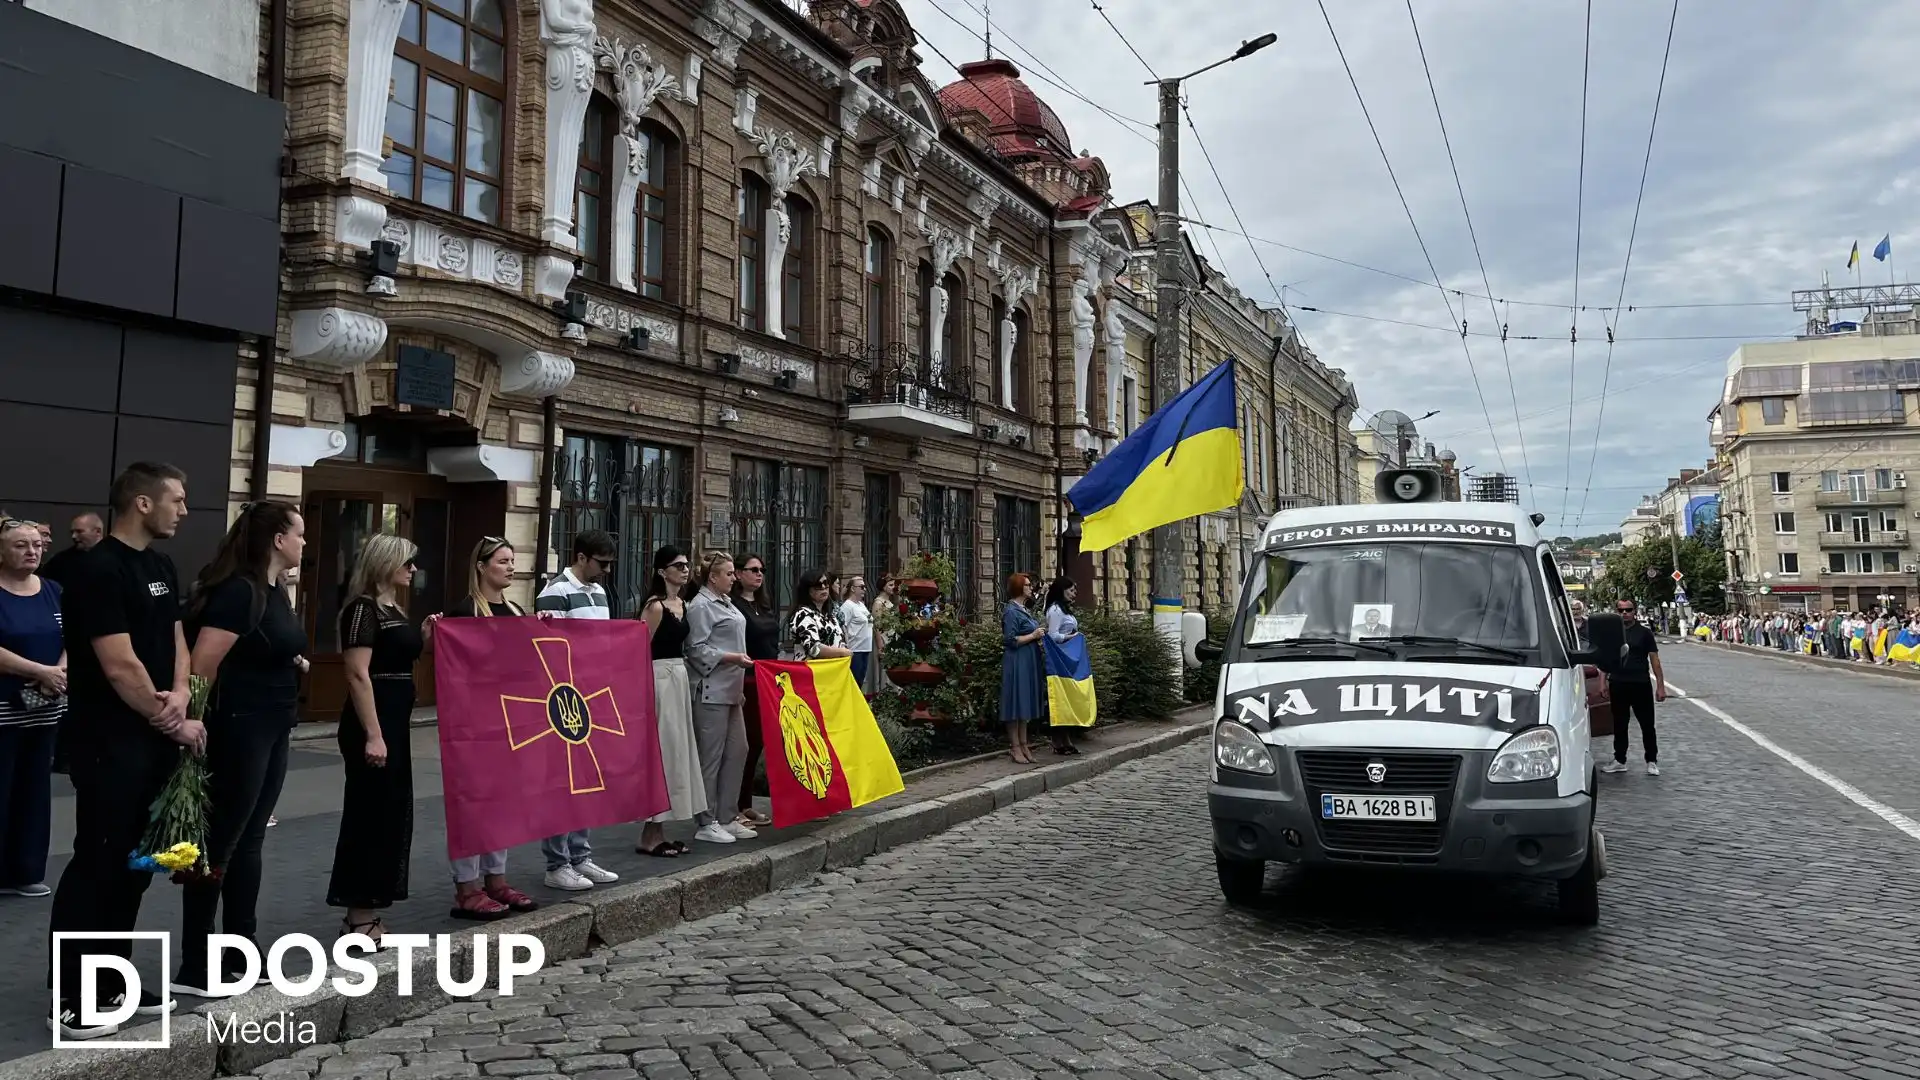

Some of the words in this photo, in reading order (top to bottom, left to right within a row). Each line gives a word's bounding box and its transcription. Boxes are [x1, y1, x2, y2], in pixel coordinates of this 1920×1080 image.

[1376, 523, 1513, 538] ВМИРАЮТЬ
[1334, 799, 1357, 815] BA
[1363, 799, 1400, 816] 1628
